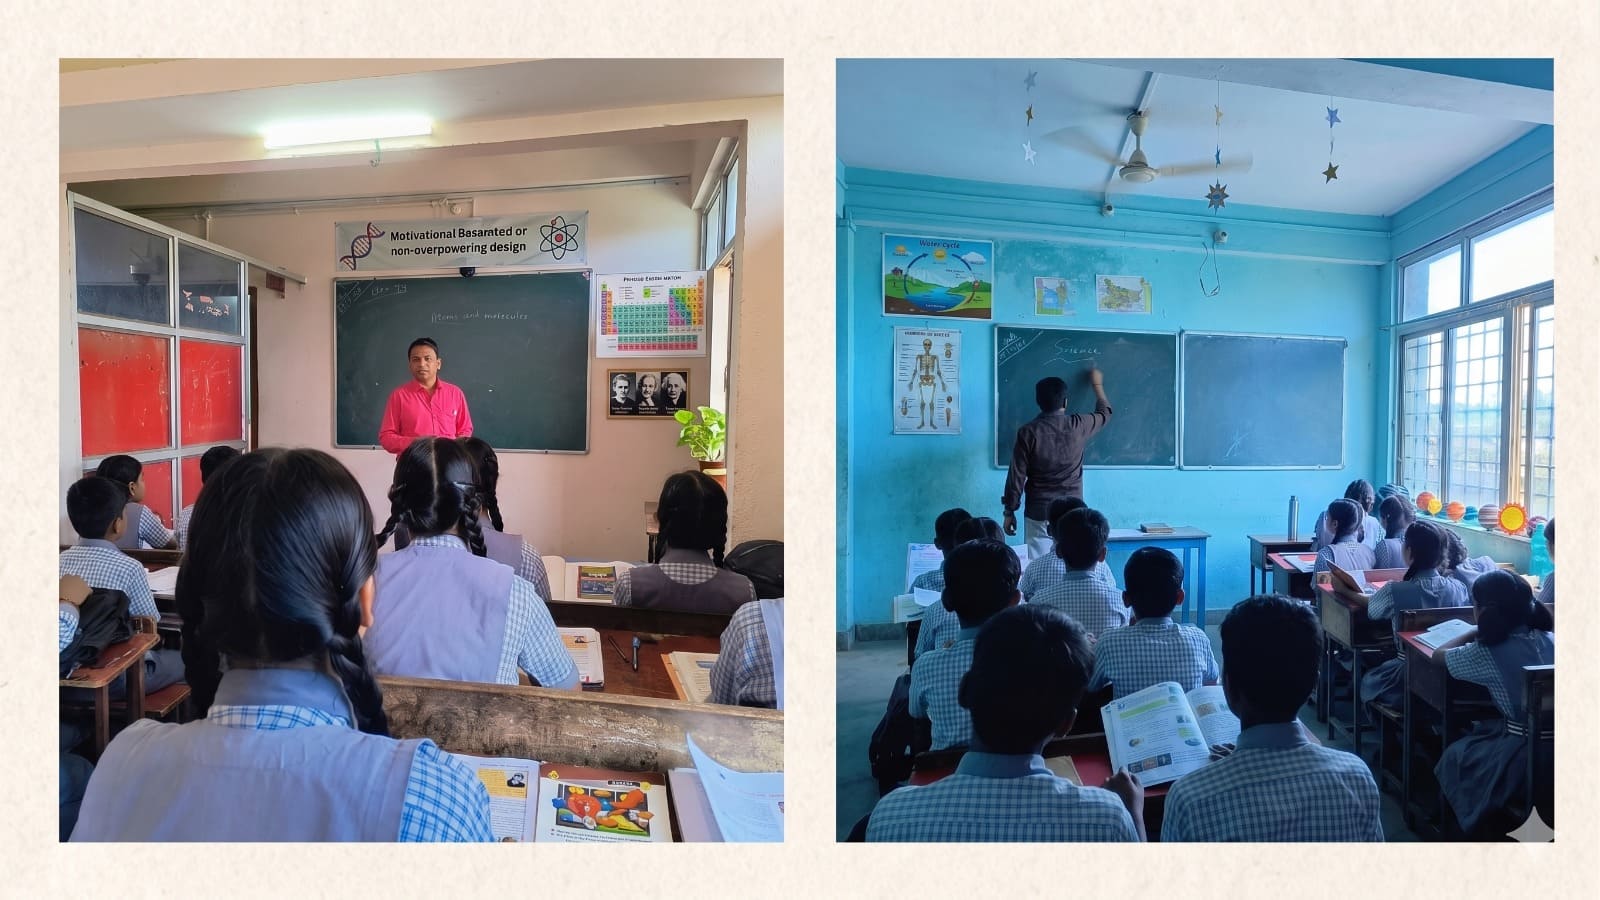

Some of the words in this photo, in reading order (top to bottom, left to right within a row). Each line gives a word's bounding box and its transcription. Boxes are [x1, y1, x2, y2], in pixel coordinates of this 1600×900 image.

[390, 228, 456, 241] Motivational
[515, 227, 528, 236] or
[391, 242, 488, 256] non-overpowering
[489, 241, 527, 253] design
